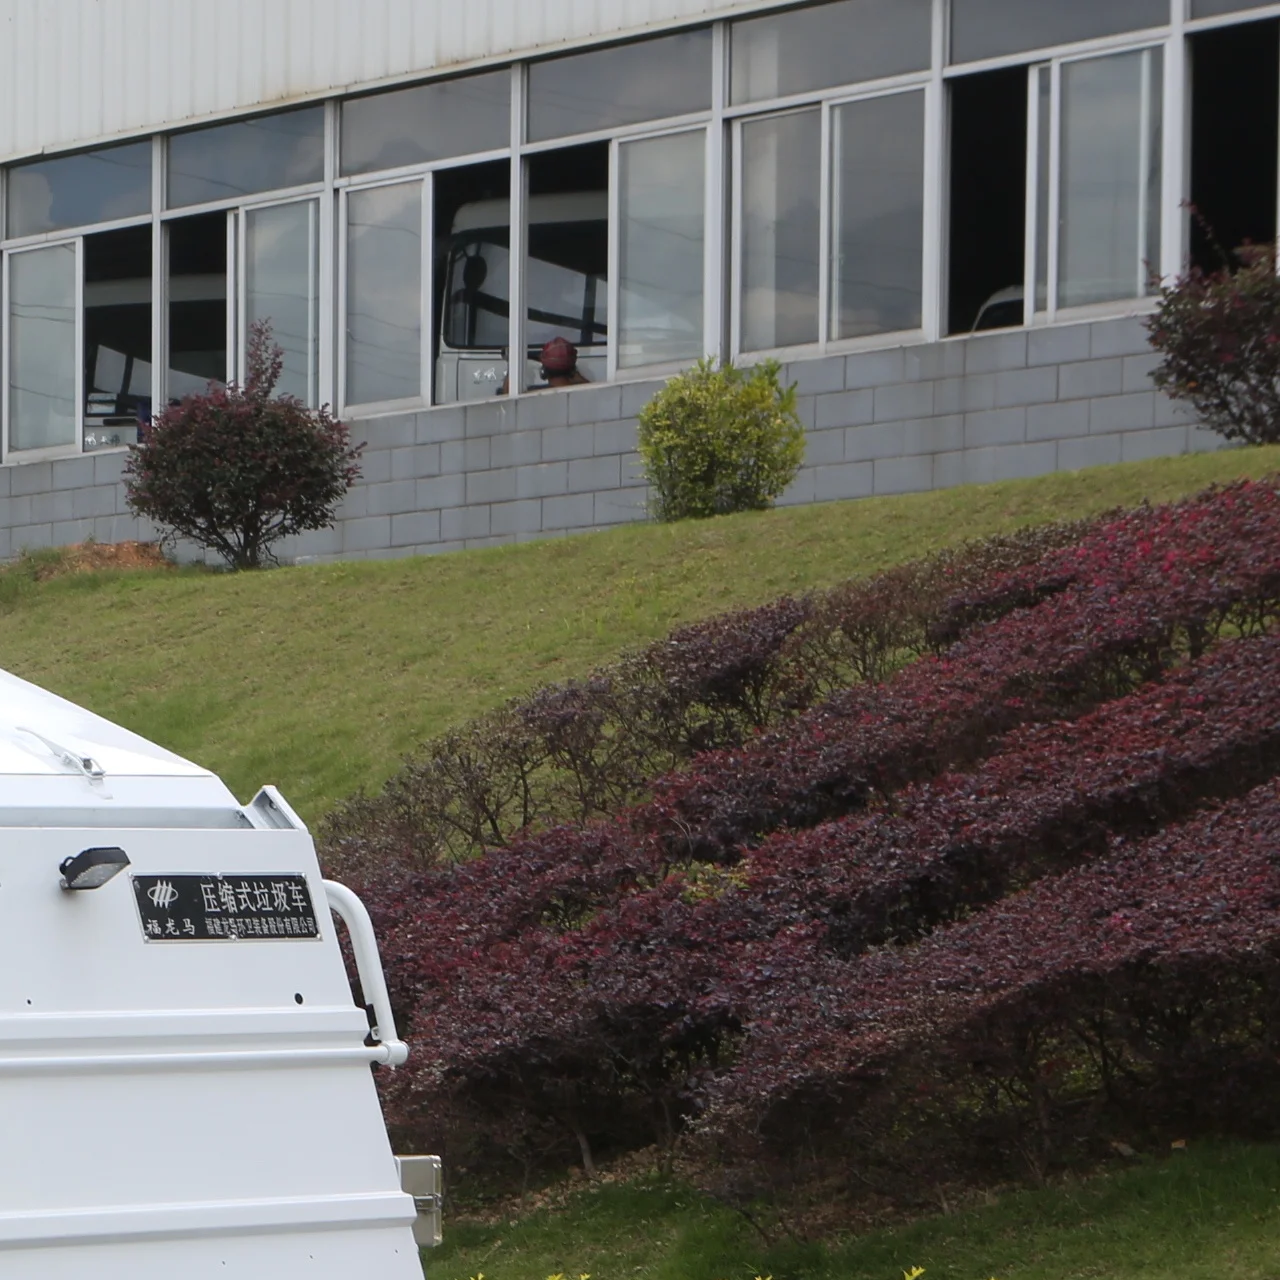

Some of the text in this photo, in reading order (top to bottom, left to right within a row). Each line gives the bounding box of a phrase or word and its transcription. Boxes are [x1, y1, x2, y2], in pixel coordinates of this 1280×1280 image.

[200, 880, 308, 913] 压缩式垃圾车
[145, 918, 196, 936] 福龙马
